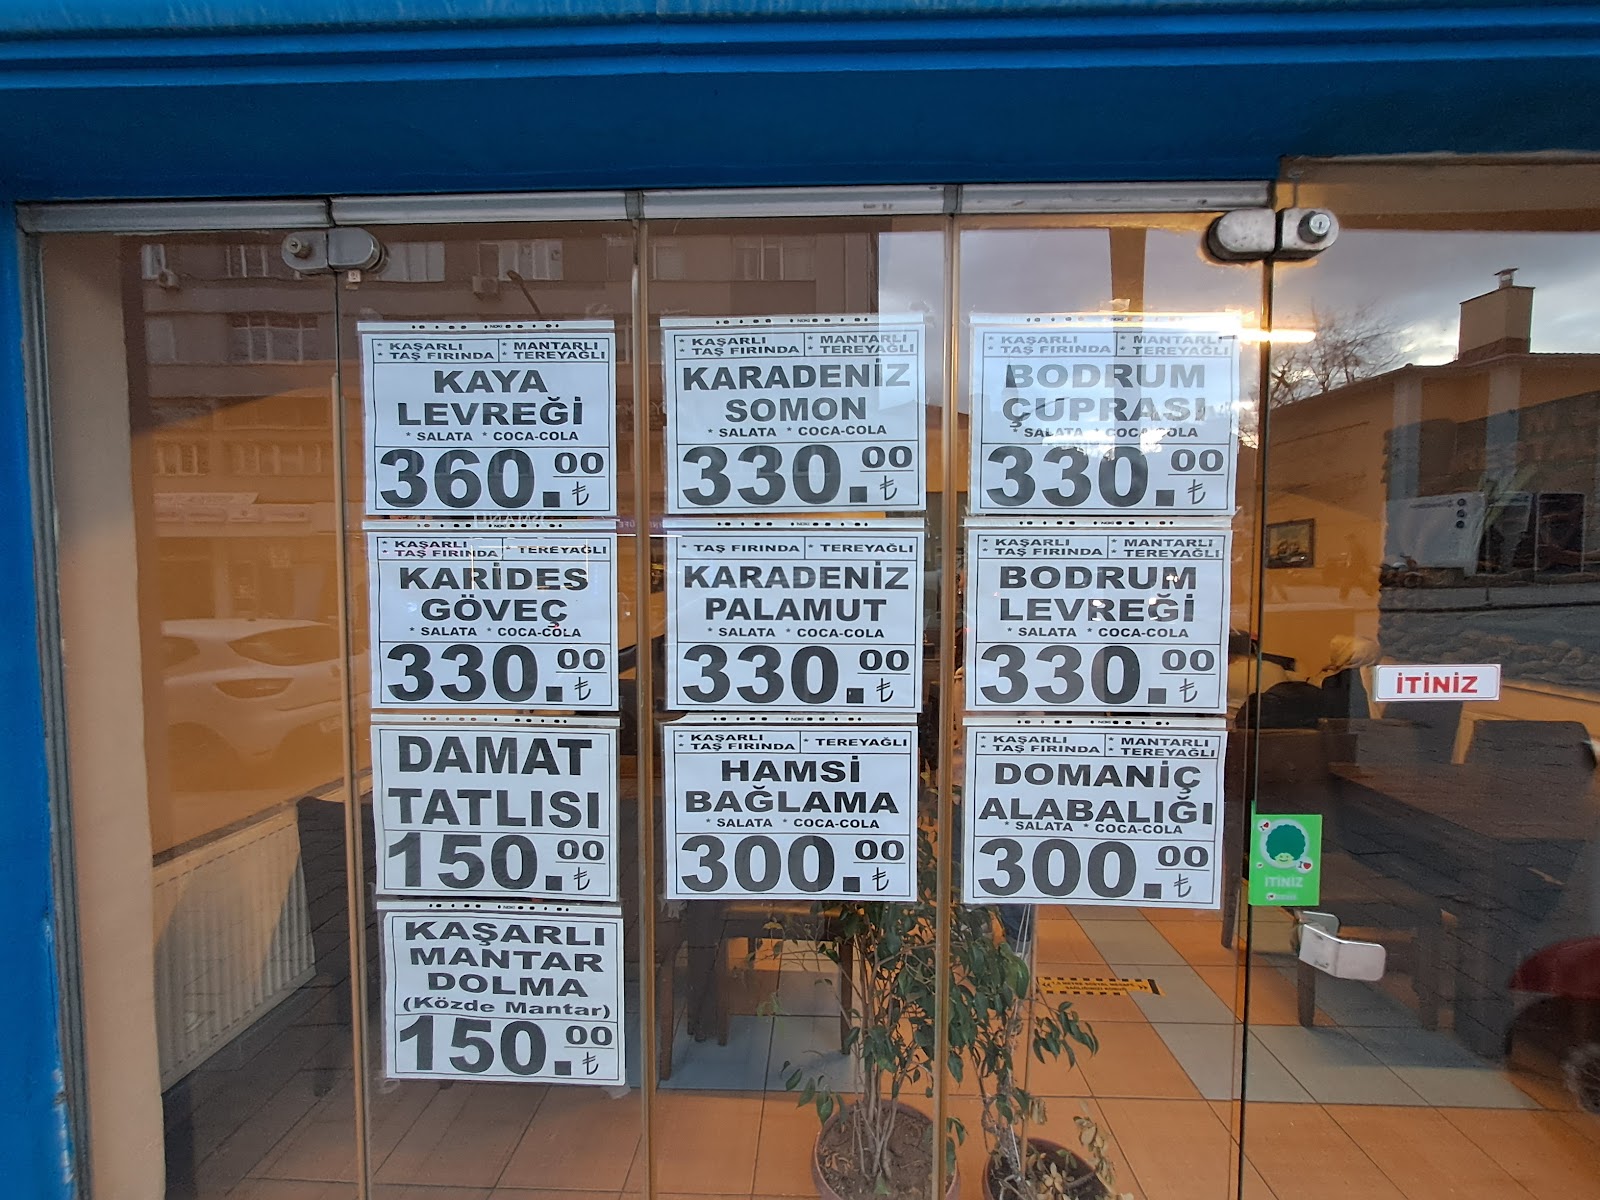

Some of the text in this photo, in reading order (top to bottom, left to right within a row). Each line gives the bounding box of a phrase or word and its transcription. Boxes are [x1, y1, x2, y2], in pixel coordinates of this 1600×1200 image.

[692, 337, 766, 347] KAŞARLI
[820, 334, 907, 343] MANTARLI
[1001, 336, 1078, 346] KAŞARLI
[390, 343, 463, 351] KAŞARLI
[514, 342, 598, 350] MANTARLI
[692, 346, 800, 356] TAŞ FIRINDA
[820, 343, 914, 354] TEREYAĞLI
[1001, 346, 1111, 355] TAŞ FIRINDA
[1133, 344, 1228, 355] TEREYAĞLI
[390, 352, 420, 360] TAŞ
[514, 349, 605, 360] TEREYAĞLI
[683, 358, 910, 390] KARADENİZ
[1006, 364, 1205, 388] BODRUM
[434, 370, 548, 393] KAYA
[398, 396, 583, 425] LEVREĞİ
[725, 397, 866, 422] SOMON
[1003, 397, 1205, 428] ÇUPRASI
[417, 432, 578, 441] SALATA COCA-COLA
[719, 426, 886, 437] SALATA COCA-COLA
[1024, 428, 1083, 437] SALATA
[380, 449, 560, 508] 360.
[554, 452, 604, 474] 00
[682, 444, 867, 505] 330.
[862, 446, 912, 468] 00
[986, 446, 1175, 507] 330.
[1170, 449, 1224, 472] 00
[395, 541, 467, 550] KAŞARLI
[520, 543, 606, 554] TEREYAĞLI
[694, 545, 800, 554] TAŞ FIRINDA
[820, 543, 913, 553] TEREYAĞLI
[996, 538, 1069, 548] KAŞARLI
[1124, 539, 1213, 547] MANTARLI
[395, 550, 426, 558] TAŞ
[1125, 548, 1219, 558] TEREYAĞLI
[400, 562, 588, 590] KARİDES
[684, 560, 908, 590] KARADENİZ
[1000, 566, 1196, 589] BODRUM
[421, 594, 568, 627] GÖVEÇ
[706, 598, 886, 621] PALAMUT
[1000, 593, 1194, 622] LEVREĞİ
[421, 627, 581, 637] SALATA COCA-COLA
[719, 628, 884, 638] SALATA COCA-COLA
[1018, 628, 1188, 638] SALATA COCA-COLA
[387, 644, 563, 702] 330.
[557, 649, 605, 670] 00
[682, 644, 864, 704] 330.
[859, 649, 909, 671] 00
[980, 644, 1167, 704] 330.
[1162, 649, 1214, 671] 00
[1396, 672, 1478, 694] İTİNİZ
[691, 734, 763, 742] KAŞARLI
[815, 737, 907, 747] TEREYAĞLI
[993, 736, 1067, 745] KAŞARLI
[1121, 738, 1209, 747] MANTARLI
[691, 743, 722, 751] TAŞ
[993, 745, 1100, 754] TAŞ FIRINDA
[1121, 747, 1215, 757] TEREYAĞLI
[398, 736, 592, 776] DAMAT
[721, 756, 860, 782] HAMSİ
[995, 760, 1201, 794] DOMANİÇ
[686, 785, 899, 814] BAĞLAMA
[388, 788, 599, 829] TATLISI
[979, 796, 1213, 825] ALABALIĞI
[717, 819, 880, 829] SALATA COCA-COLA
[1016, 821, 1183, 834] SALATA COCA-COLA
[388, 832, 562, 891] 150.
[557, 840, 604, 860] 00
[681, 835, 860, 893] 300.
[855, 840, 904, 861] 00
[978, 838, 1162, 899] 300.
[1157, 846, 1208, 867] 00
[405, 922, 605, 946] KAŞARLI
[410, 948, 604, 972] MANTAR
[428, 972, 588, 997] DOLMA
[403, 997, 611, 1019] (Közde Mantar)
[400, 1015, 572, 1076] 150.
[566, 1025, 613, 1046] 00
